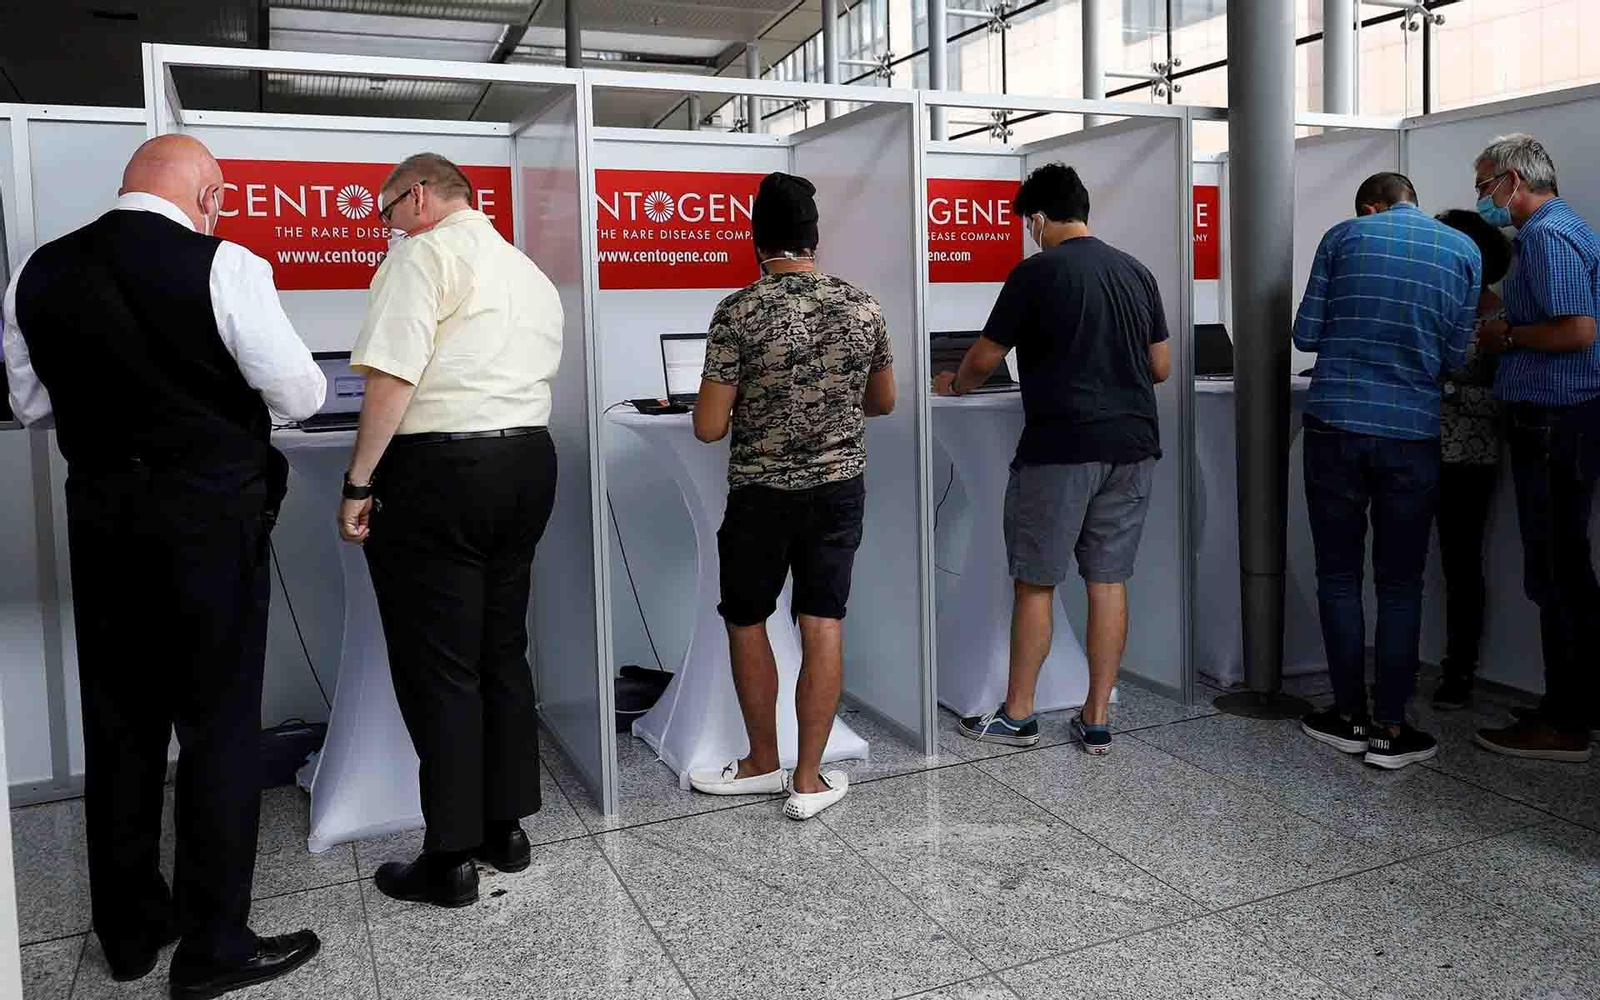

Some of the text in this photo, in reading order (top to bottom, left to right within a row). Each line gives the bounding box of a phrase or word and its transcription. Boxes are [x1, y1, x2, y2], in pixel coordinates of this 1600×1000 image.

[928, 197, 1011, 226] GENE
[1196, 203, 1208, 227] E
[275, 226, 303, 238] THE
[311, 226, 349, 238] RARE
[623, 229, 654, 239] RARE
[660, 229, 711, 240] DISEASE
[960, 232, 1011, 241] COMPANY
[596, 249, 728, 266] www.centogene.com
